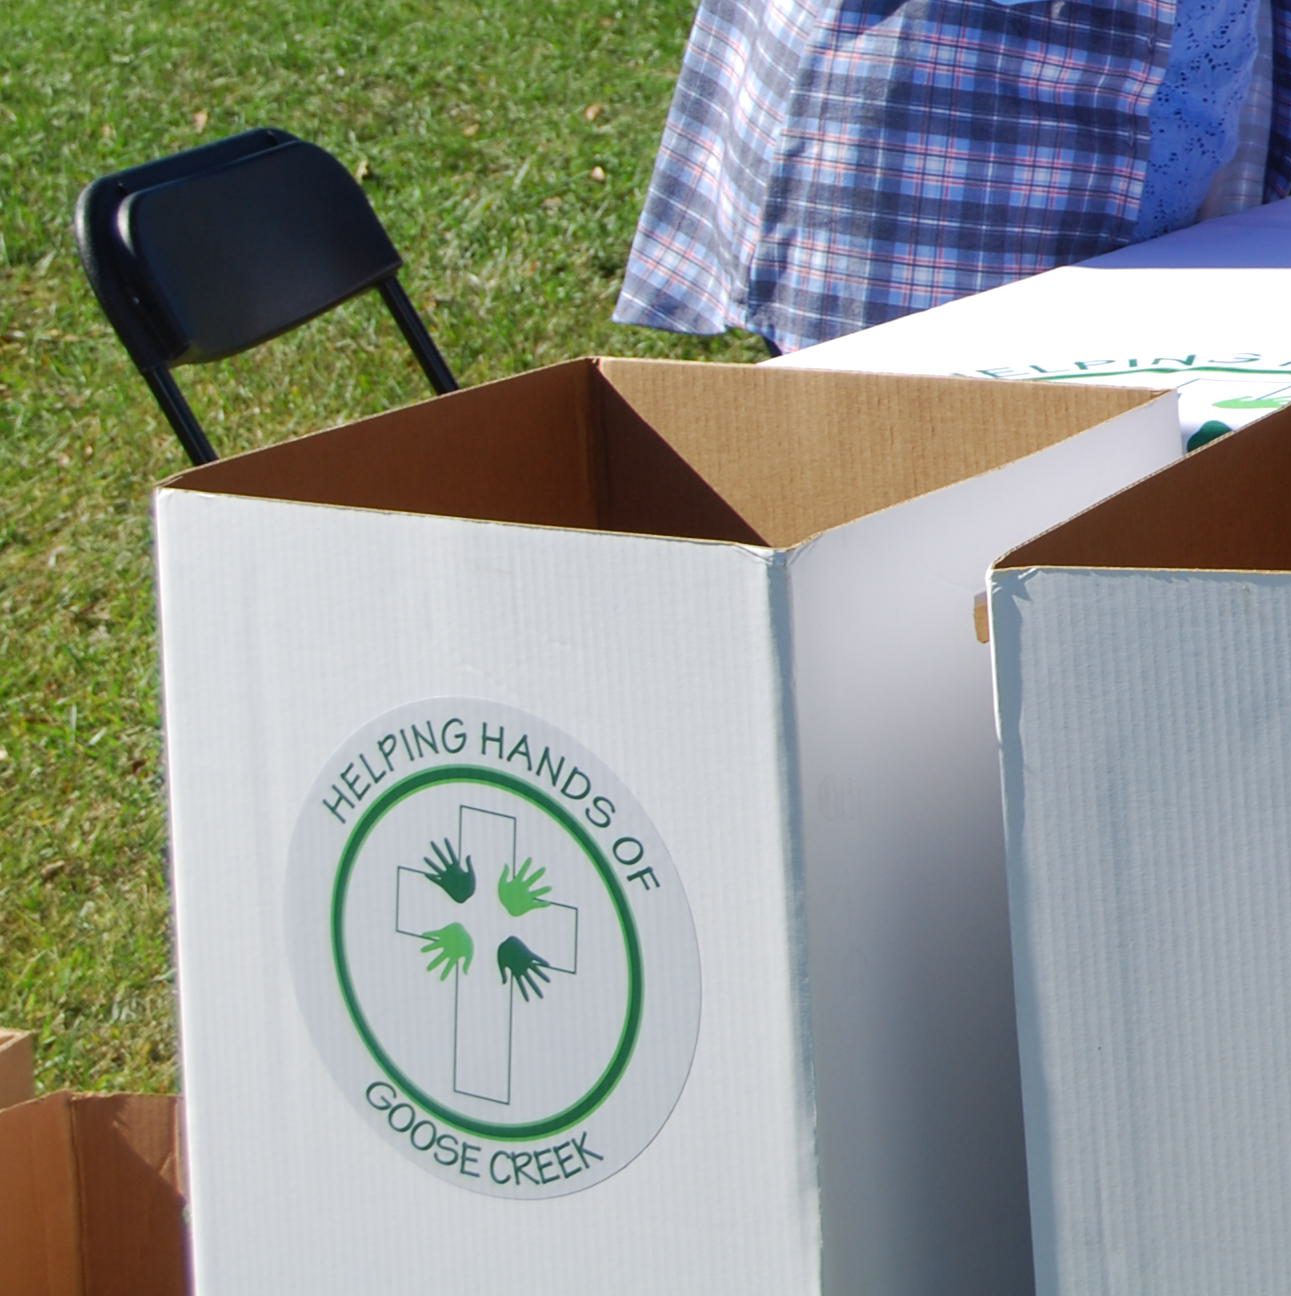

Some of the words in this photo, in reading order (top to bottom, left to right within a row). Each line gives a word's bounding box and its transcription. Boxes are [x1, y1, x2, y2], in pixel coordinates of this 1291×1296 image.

[952, 353, 1262, 379] ELPING
[323, 718, 468, 824] HELPING
[481, 722, 616, 829] HANDS
[612, 836, 661, 892] OF
[365, 1081, 482, 1178] GOOSE
[489, 1131, 604, 1186] CREEK
